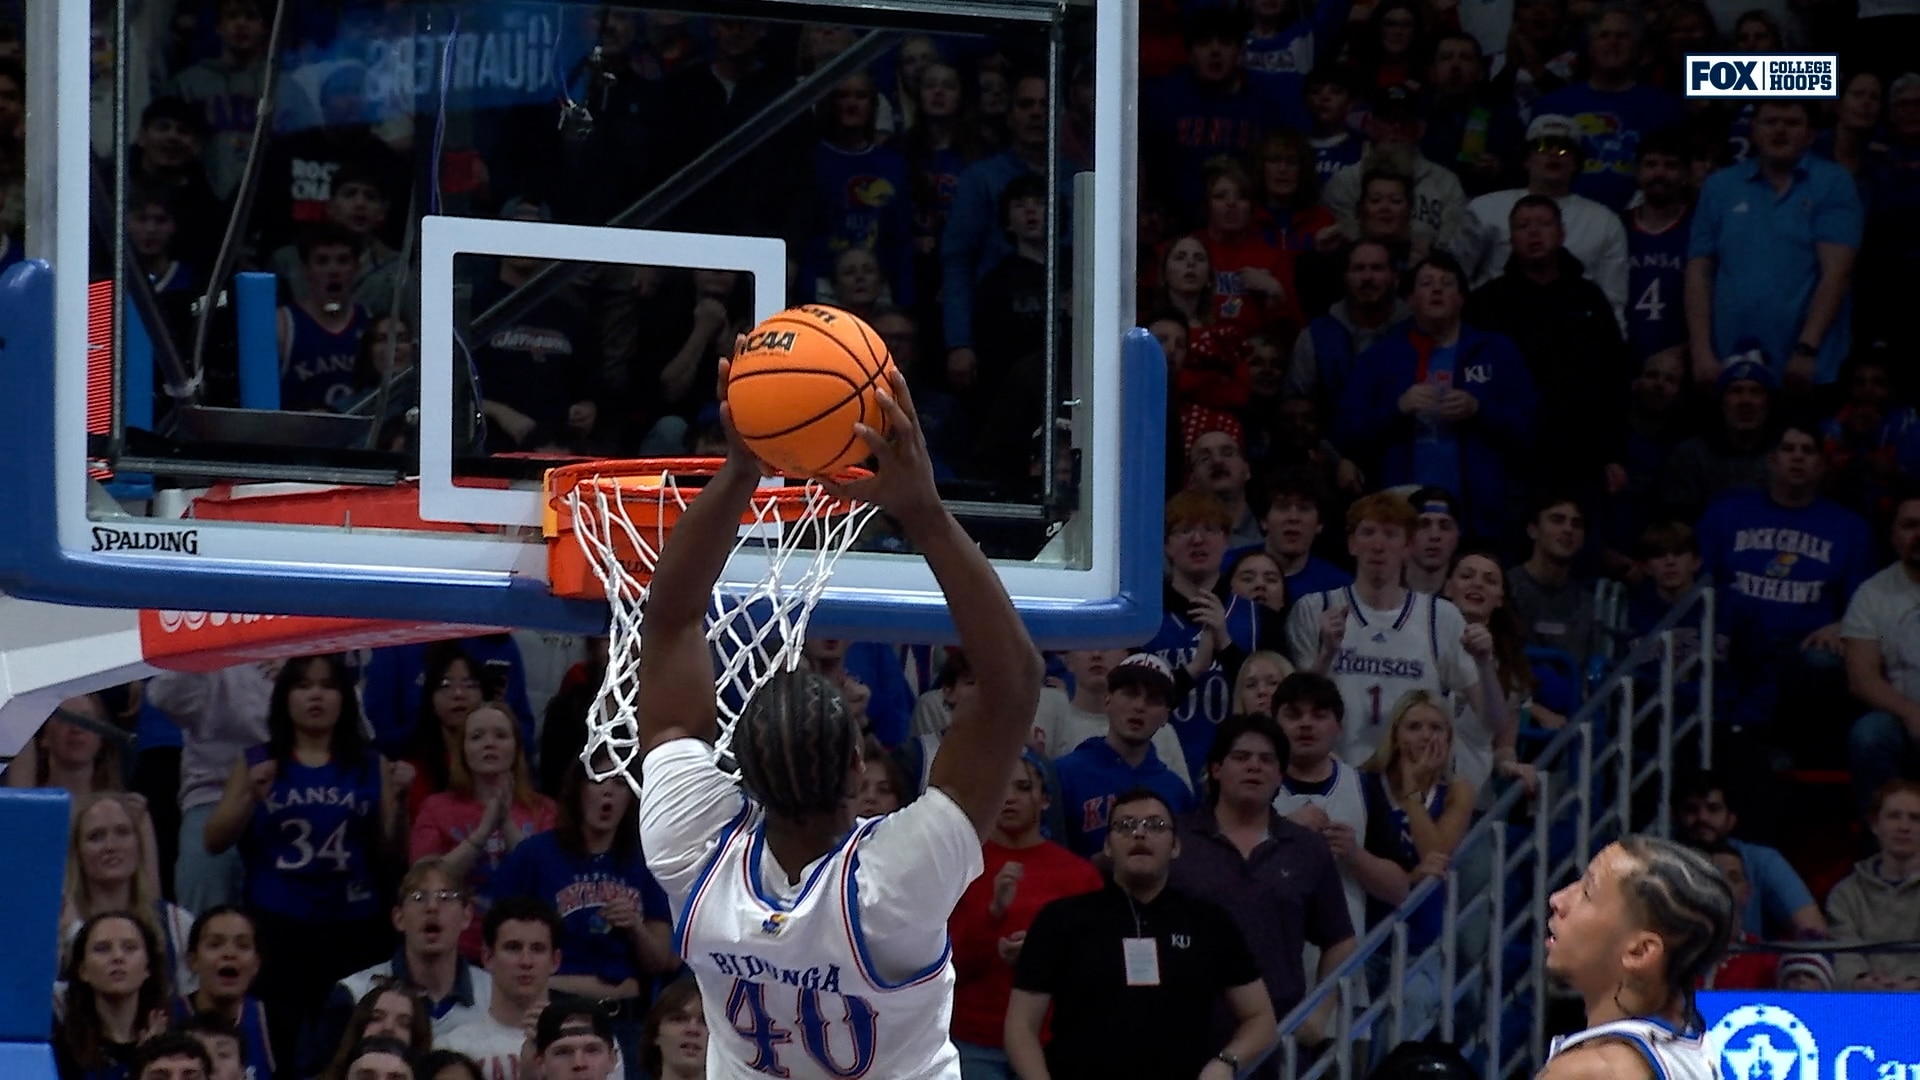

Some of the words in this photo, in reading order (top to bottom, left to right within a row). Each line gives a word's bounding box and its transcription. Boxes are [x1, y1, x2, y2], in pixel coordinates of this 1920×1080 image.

[1634, 276, 1668, 321] 4
[1463, 364, 1493, 383] KU
[91, 526, 198, 555] SPALDING
[1733, 527, 1776, 553] ROCK
[1774, 527, 1835, 565] CHALK
[1333, 647, 1426, 678] Kansas
[1366, 684, 1383, 725] 1
[276, 818, 352, 871] 34
[1171, 933, 1191, 950] KU
[725, 977, 880, 1080] 40
[1834, 1045, 1920, 1080] Ca
